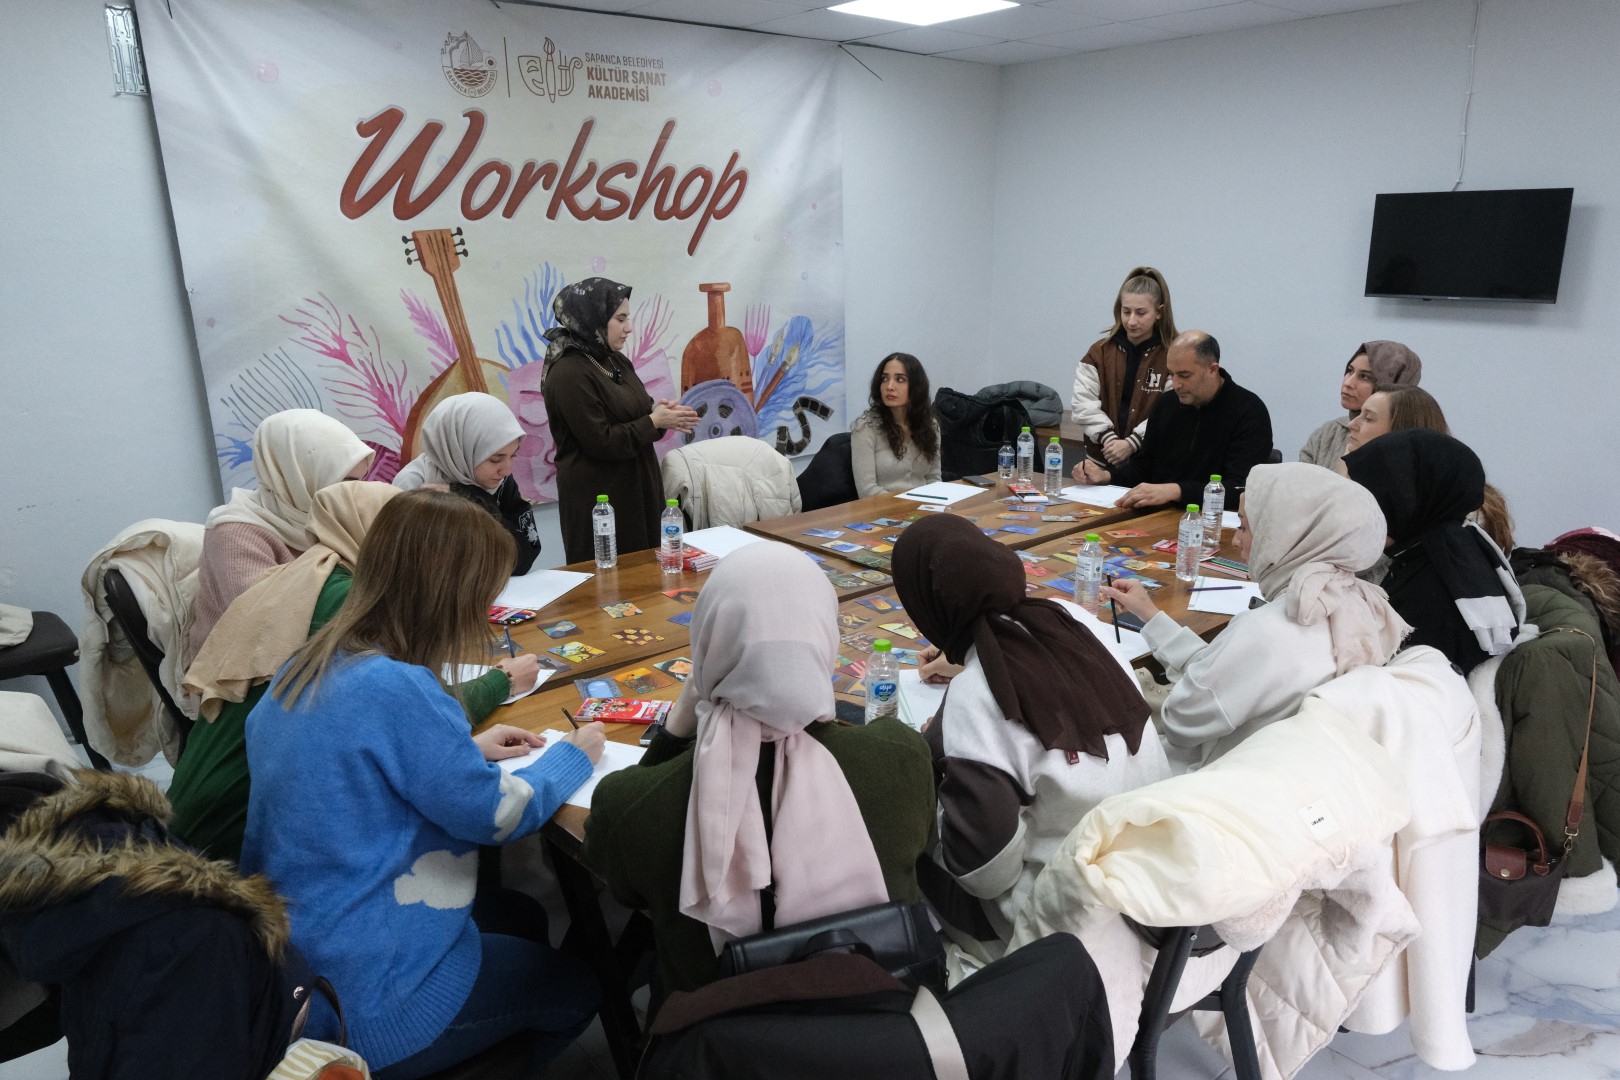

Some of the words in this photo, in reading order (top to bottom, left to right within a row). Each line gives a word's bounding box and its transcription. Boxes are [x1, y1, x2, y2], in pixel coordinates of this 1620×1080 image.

[585, 52, 621, 65] SAPANCA
[623, 56, 664, 70] BELEDİYESİ
[446, 70, 468, 95] SAPANCA
[587, 65, 630, 84] KÜLTÜR
[632, 70, 666, 86] SANAT
[588, 84, 650, 102] AKADEMİSİ
[339, 107, 748, 256] Workshop
